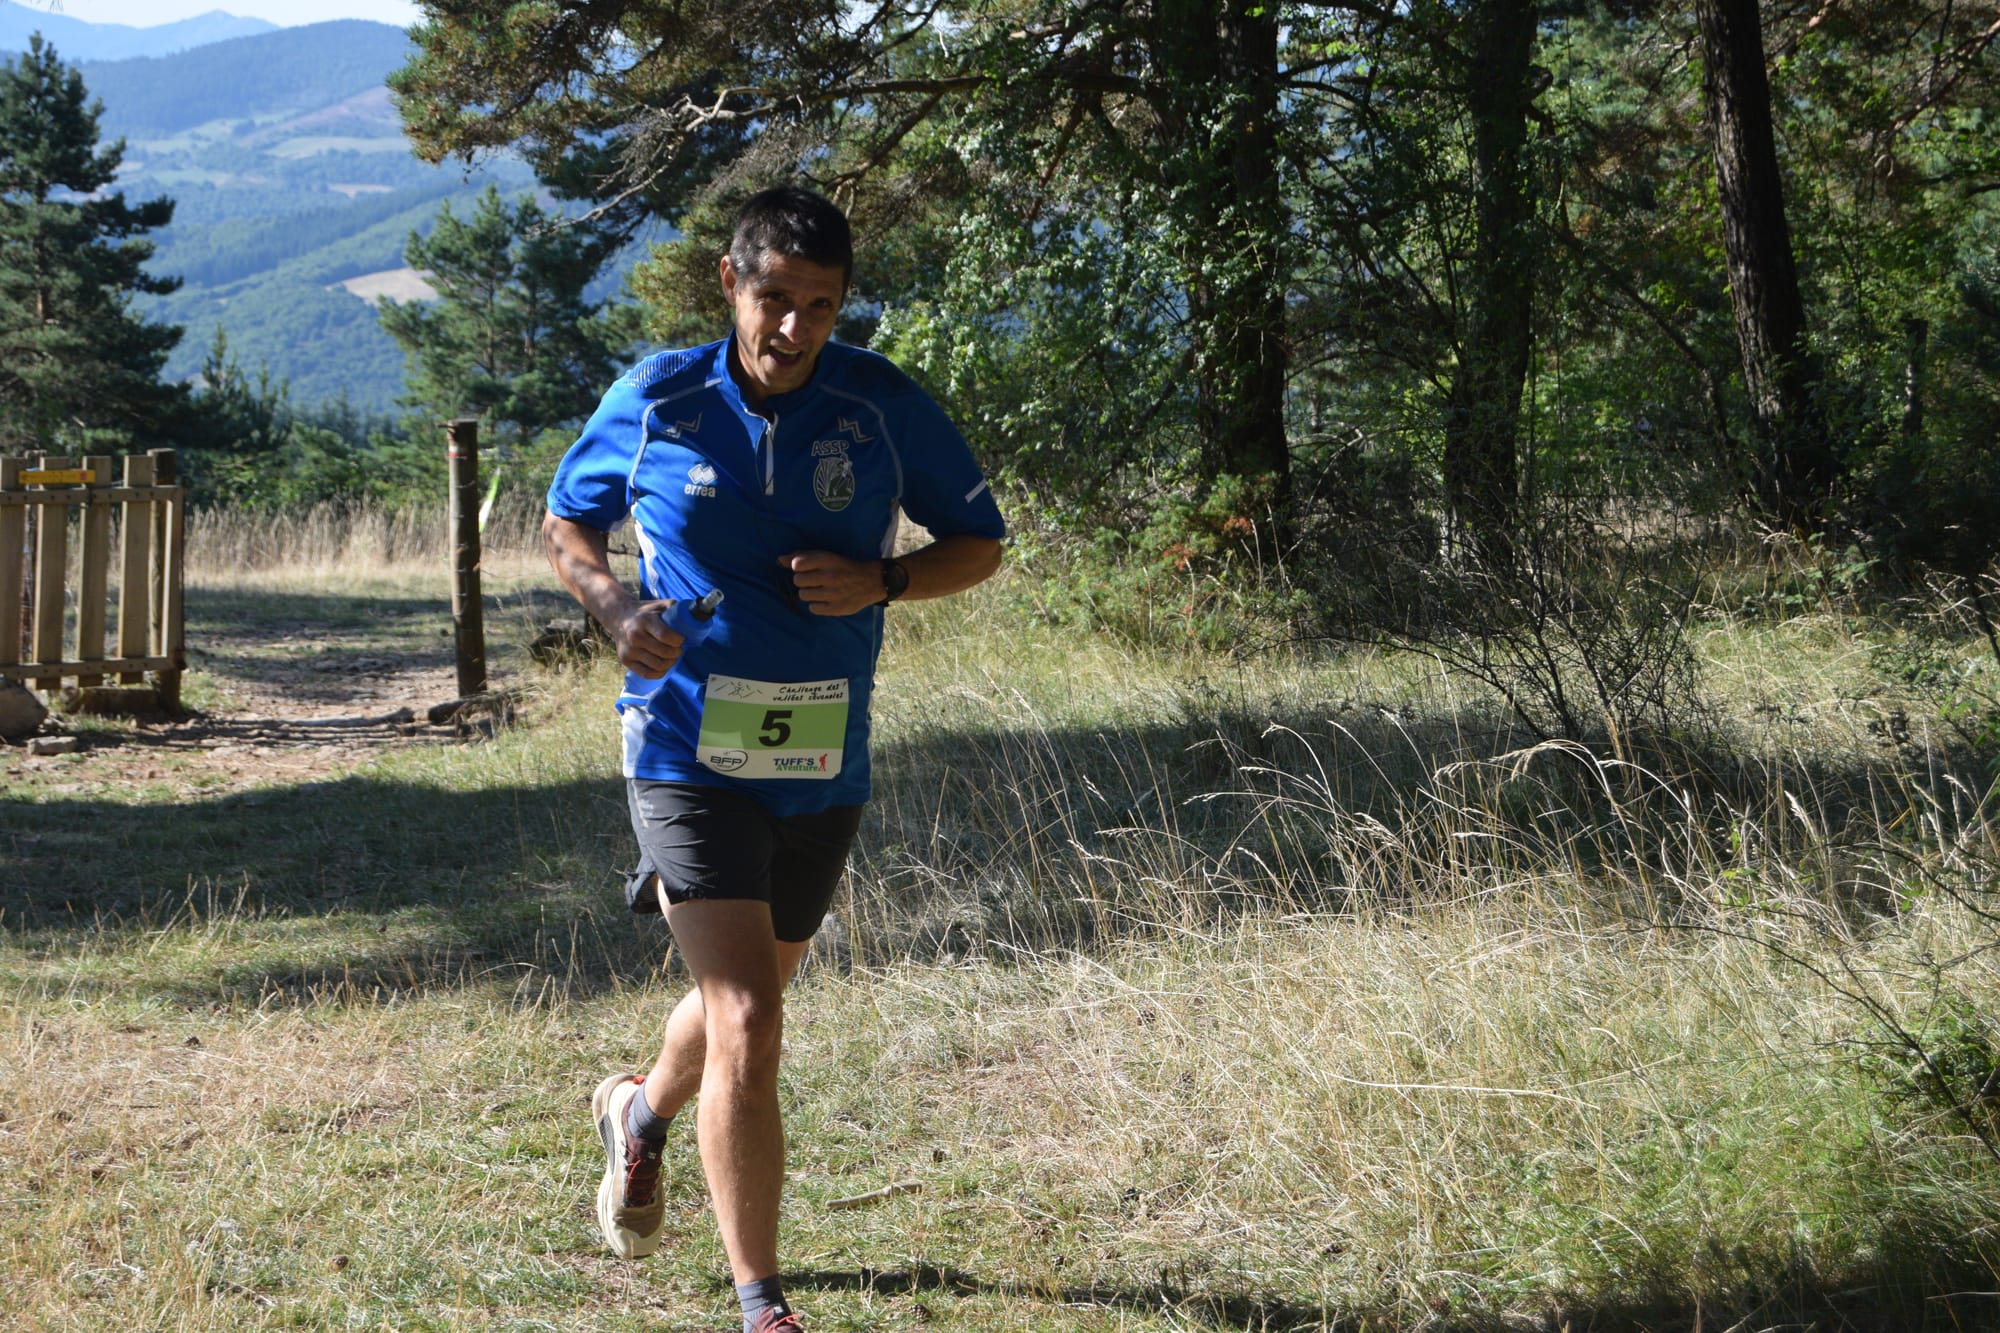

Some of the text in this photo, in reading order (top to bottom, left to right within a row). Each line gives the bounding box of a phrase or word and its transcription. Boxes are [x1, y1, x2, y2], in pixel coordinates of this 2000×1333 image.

[811, 440, 850, 456] ASSP
[779, 683, 840, 695] Challenge des
[758, 709, 793, 747] 5
[710, 755, 742, 766] BFP
[773, 757, 815, 766] TUFF'S
